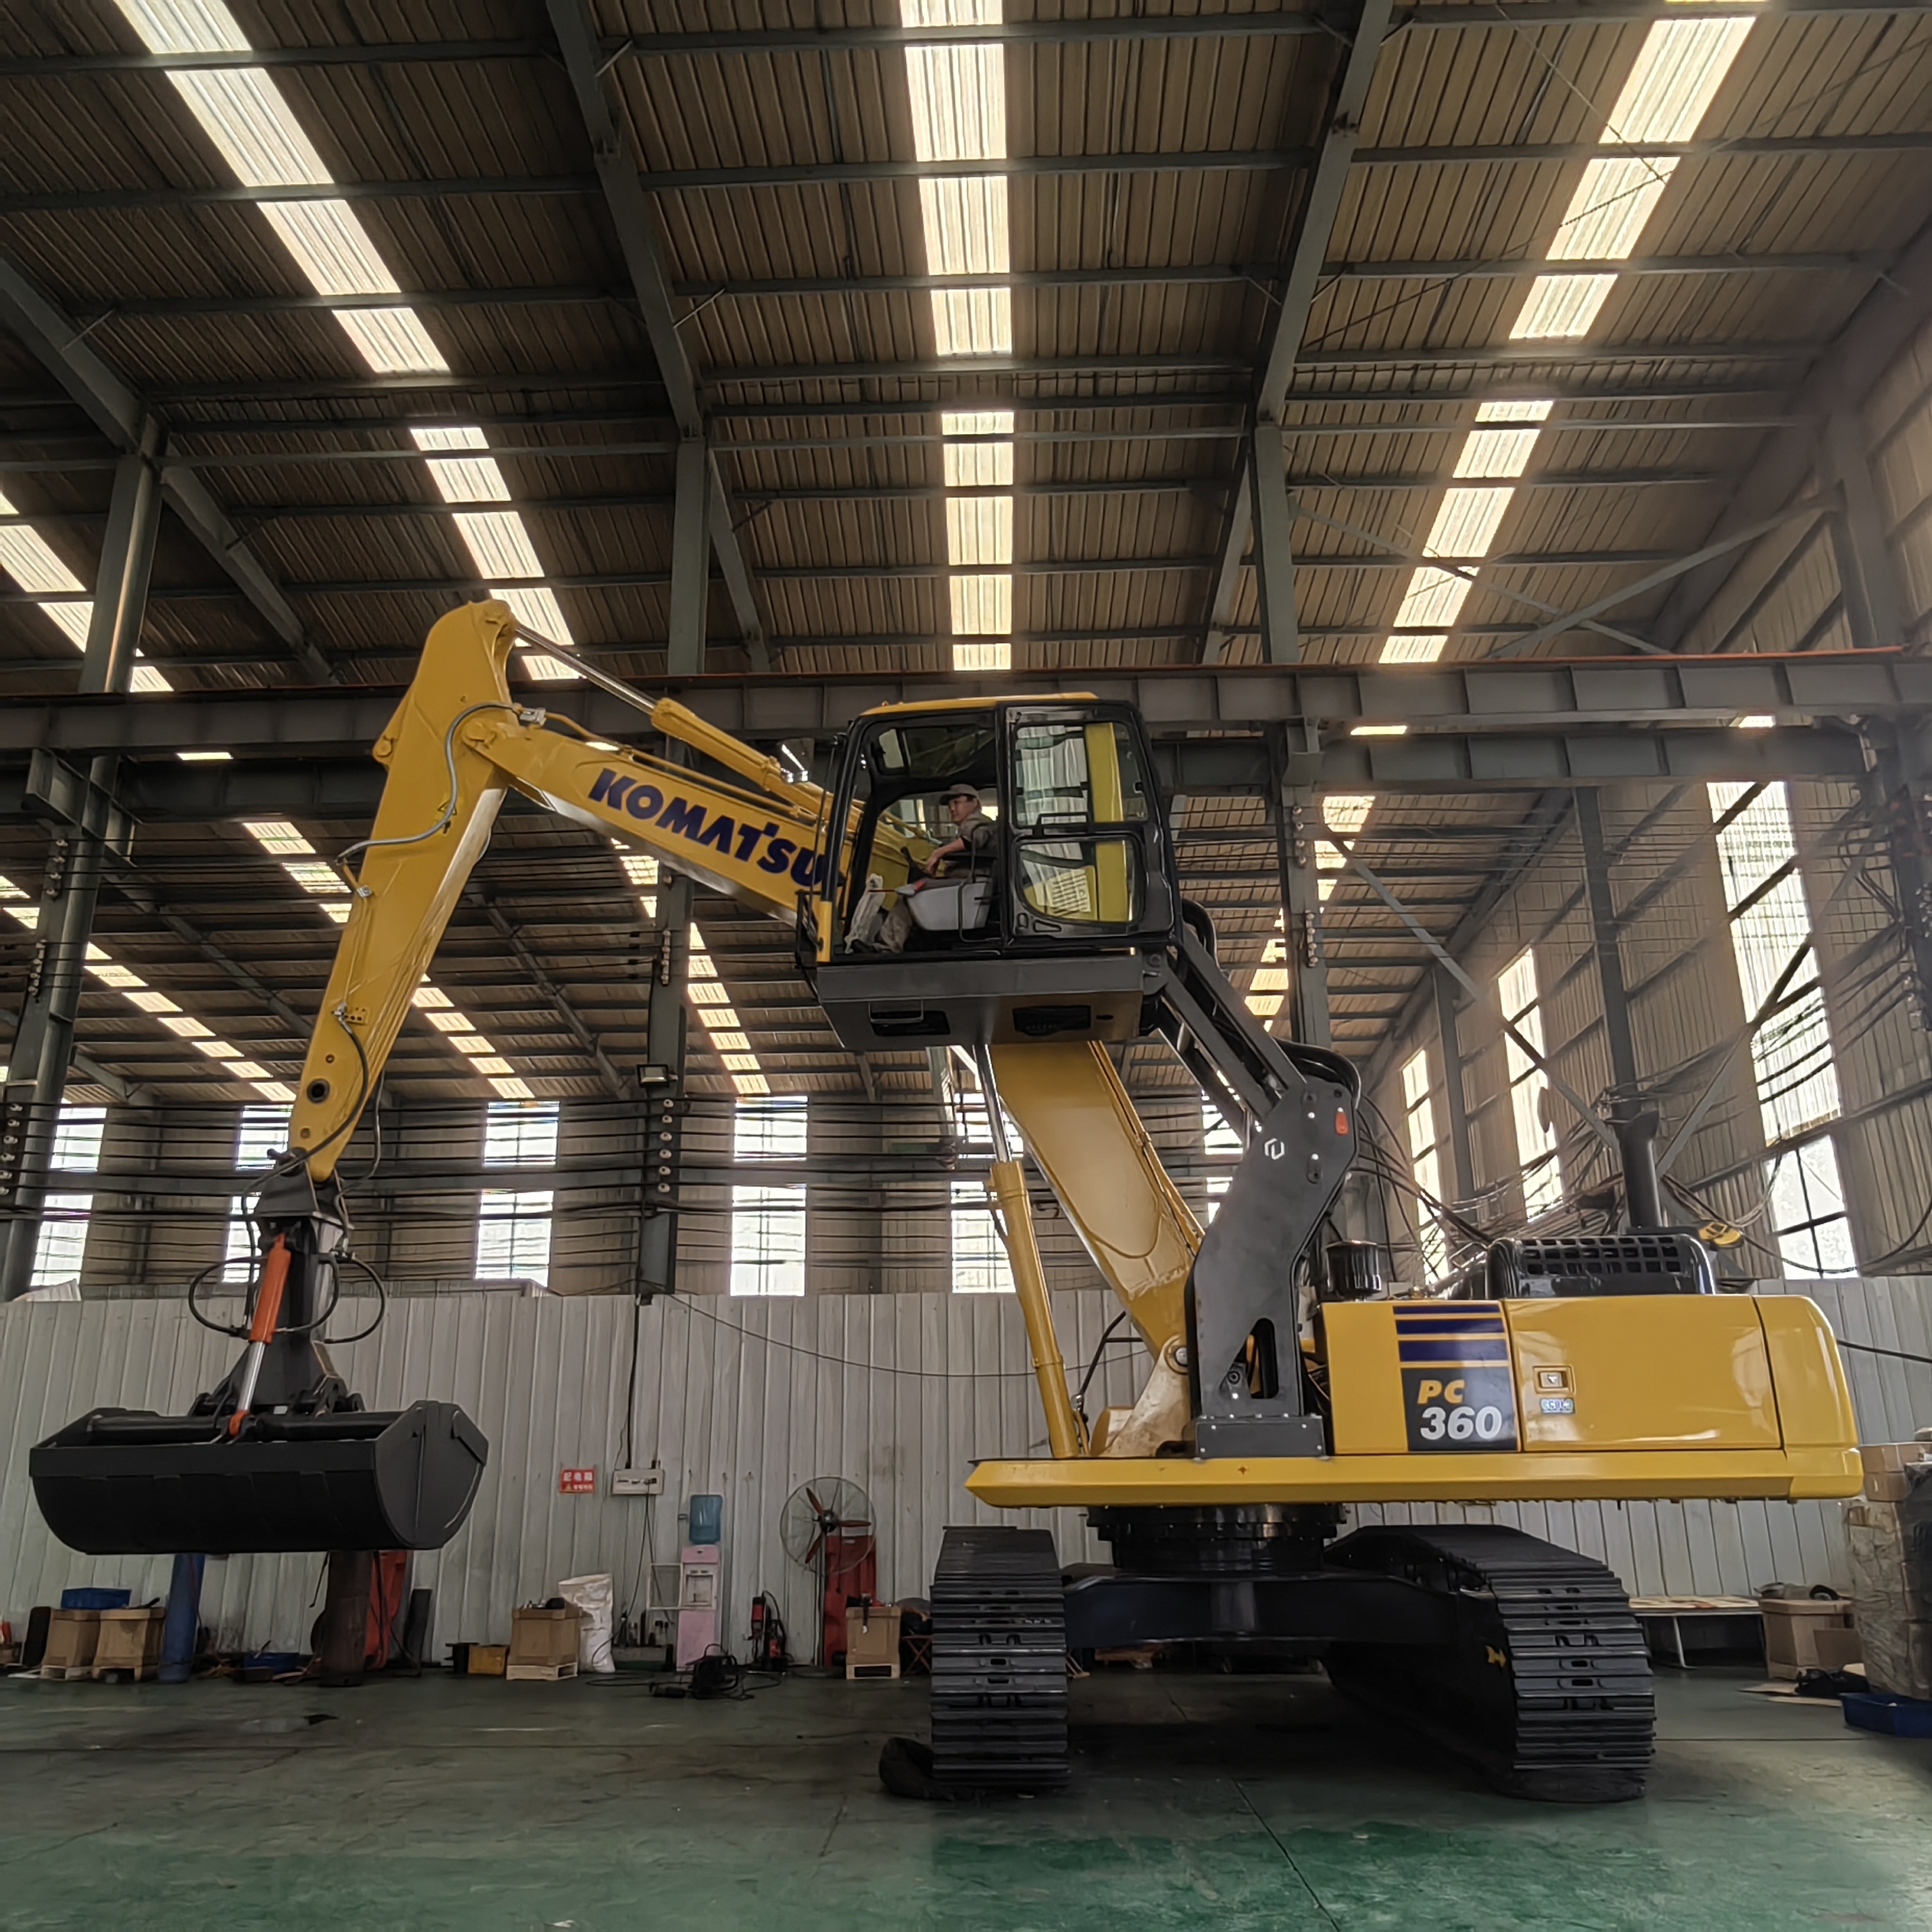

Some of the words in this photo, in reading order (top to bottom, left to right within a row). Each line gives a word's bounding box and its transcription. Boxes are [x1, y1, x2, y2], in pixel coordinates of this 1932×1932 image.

[588, 768, 829, 886] KOMATSU
[1417, 1380, 1465, 1404] PC
[1421, 1406, 1503, 1440] 360
